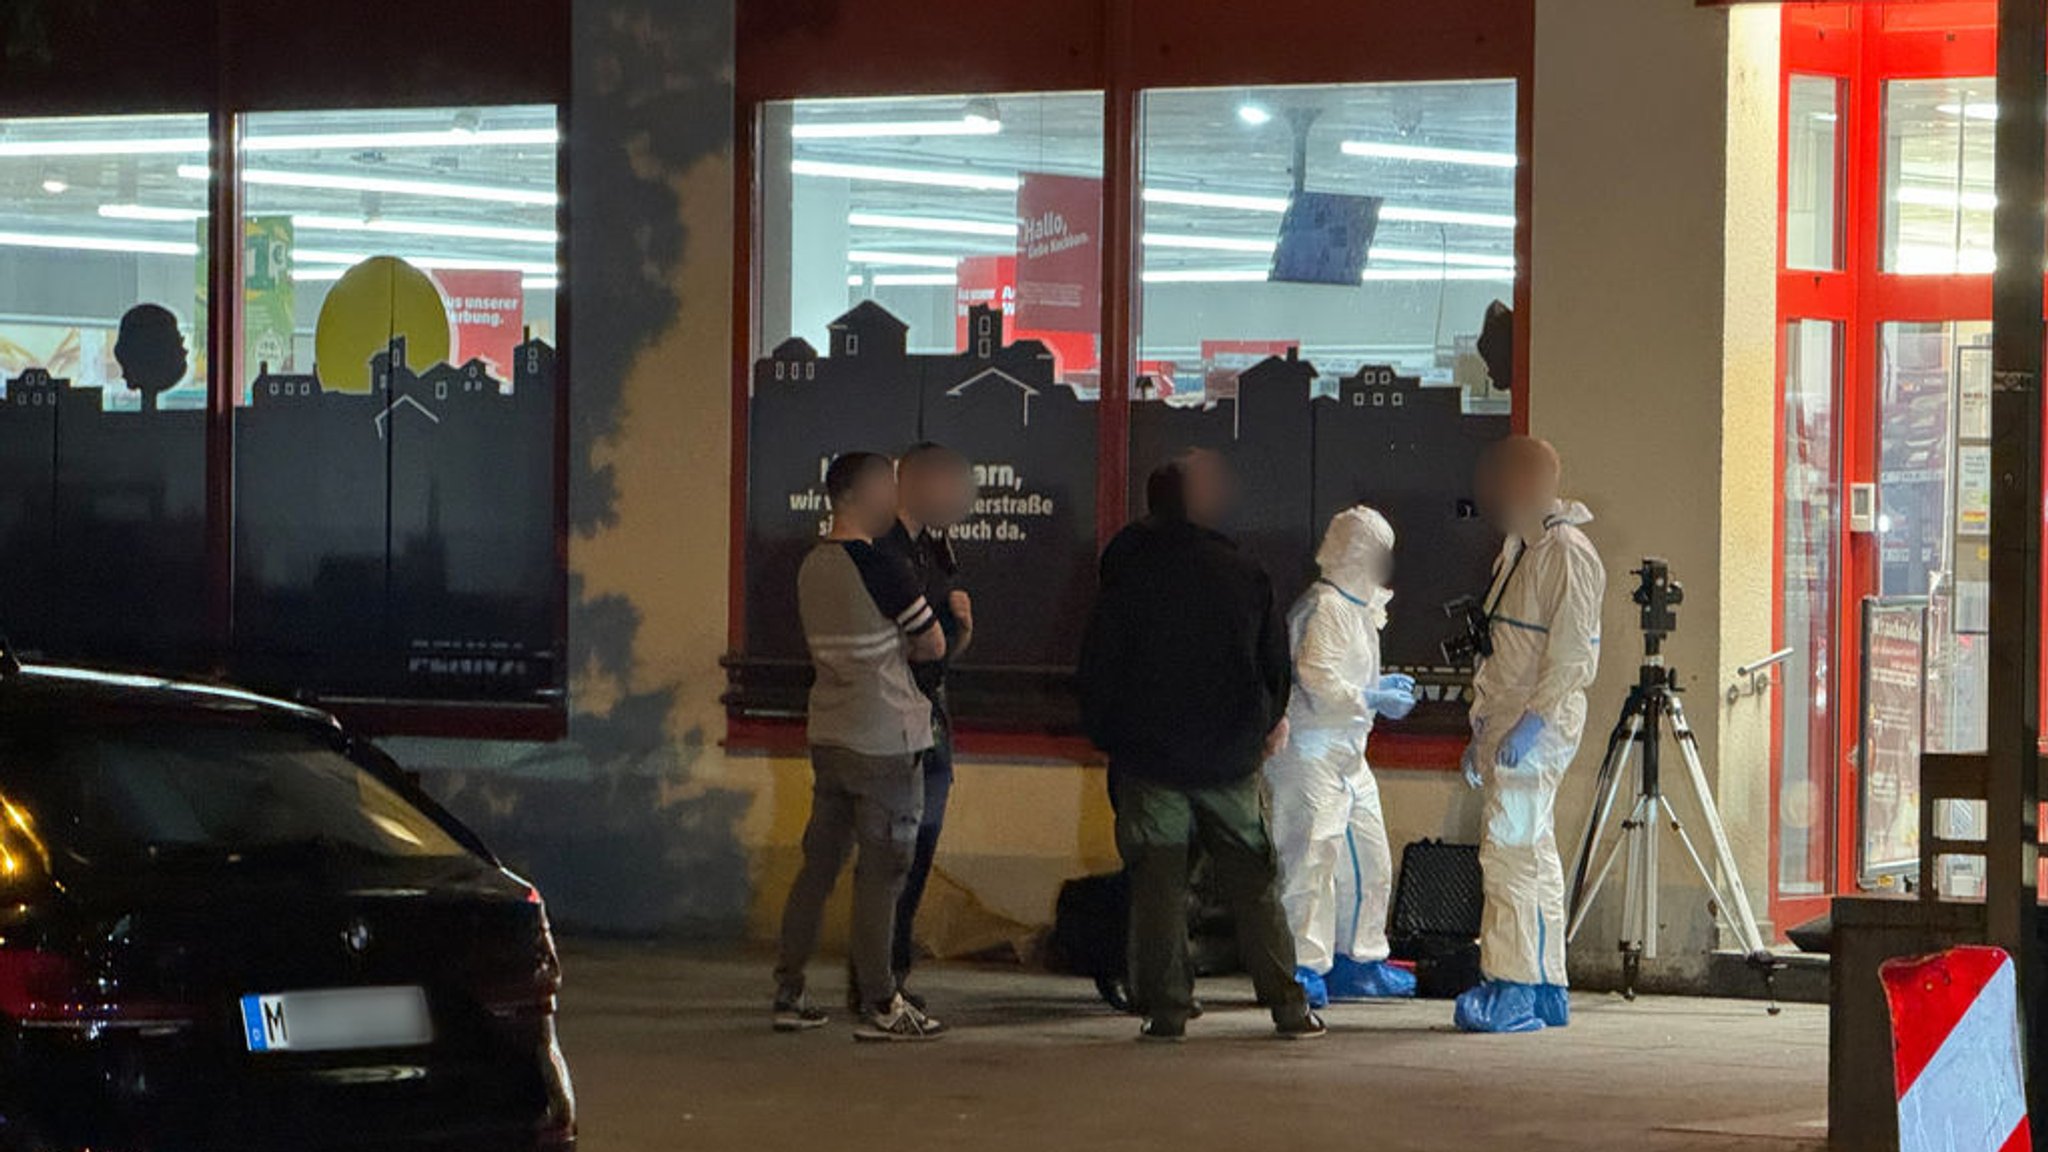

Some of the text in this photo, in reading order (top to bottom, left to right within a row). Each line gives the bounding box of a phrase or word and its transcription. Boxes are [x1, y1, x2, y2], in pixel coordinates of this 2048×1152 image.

[1024, 211, 1067, 243] Hallo,
[465, 296, 517, 310] unserer
[450, 311, 504, 327] erbung.
[789, 488, 821, 511] wir
[969, 493, 1054, 516] erstraße
[949, 520, 992, 540] euch
[995, 520, 1026, 540] da.
[264, 1001, 288, 1043] M
